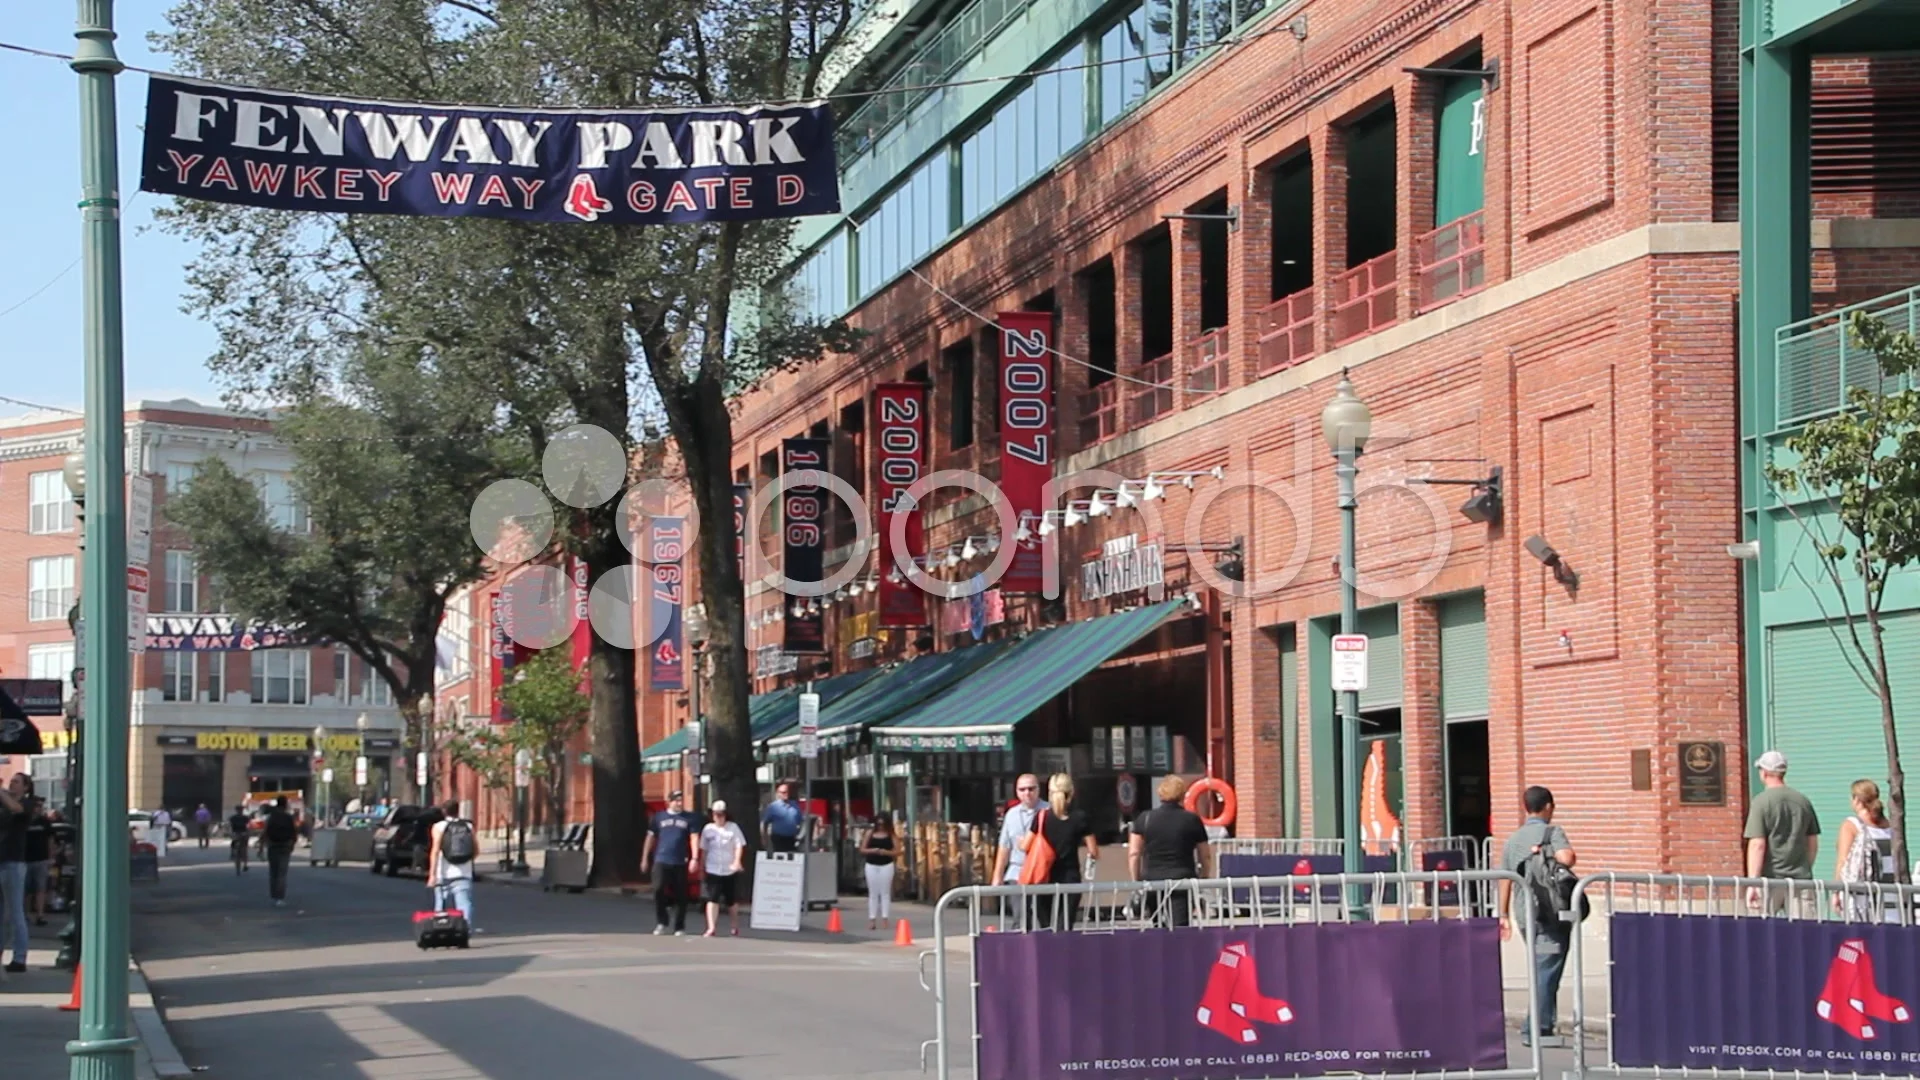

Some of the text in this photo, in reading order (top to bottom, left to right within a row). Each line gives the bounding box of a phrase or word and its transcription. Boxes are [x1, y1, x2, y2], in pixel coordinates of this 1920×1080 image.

[170, 90, 805, 169] FENWAY PARK
[168, 149, 804, 212] YAWKEY WAY GATE D
[1005, 329, 1047, 465] 2007
[882, 397, 919, 513] 2004
[787, 450, 820, 547] 1986
[653, 527, 682, 605] 1967
[145, 617, 237, 635] NWAY
[192, 635, 236, 649] WAY
[196, 732, 260, 749] BOSTON
[267, 733, 308, 750] BEER
[312, 734, 361, 750] ORKS
[1060, 1050, 1432, 1071] VISIT REDSOX.COM OR CALL (888) RED-SOX6 FOR TICKETS
[1689, 1045, 1920, 1063] VISIT REDSOX.COM OR CALL (888) RE
